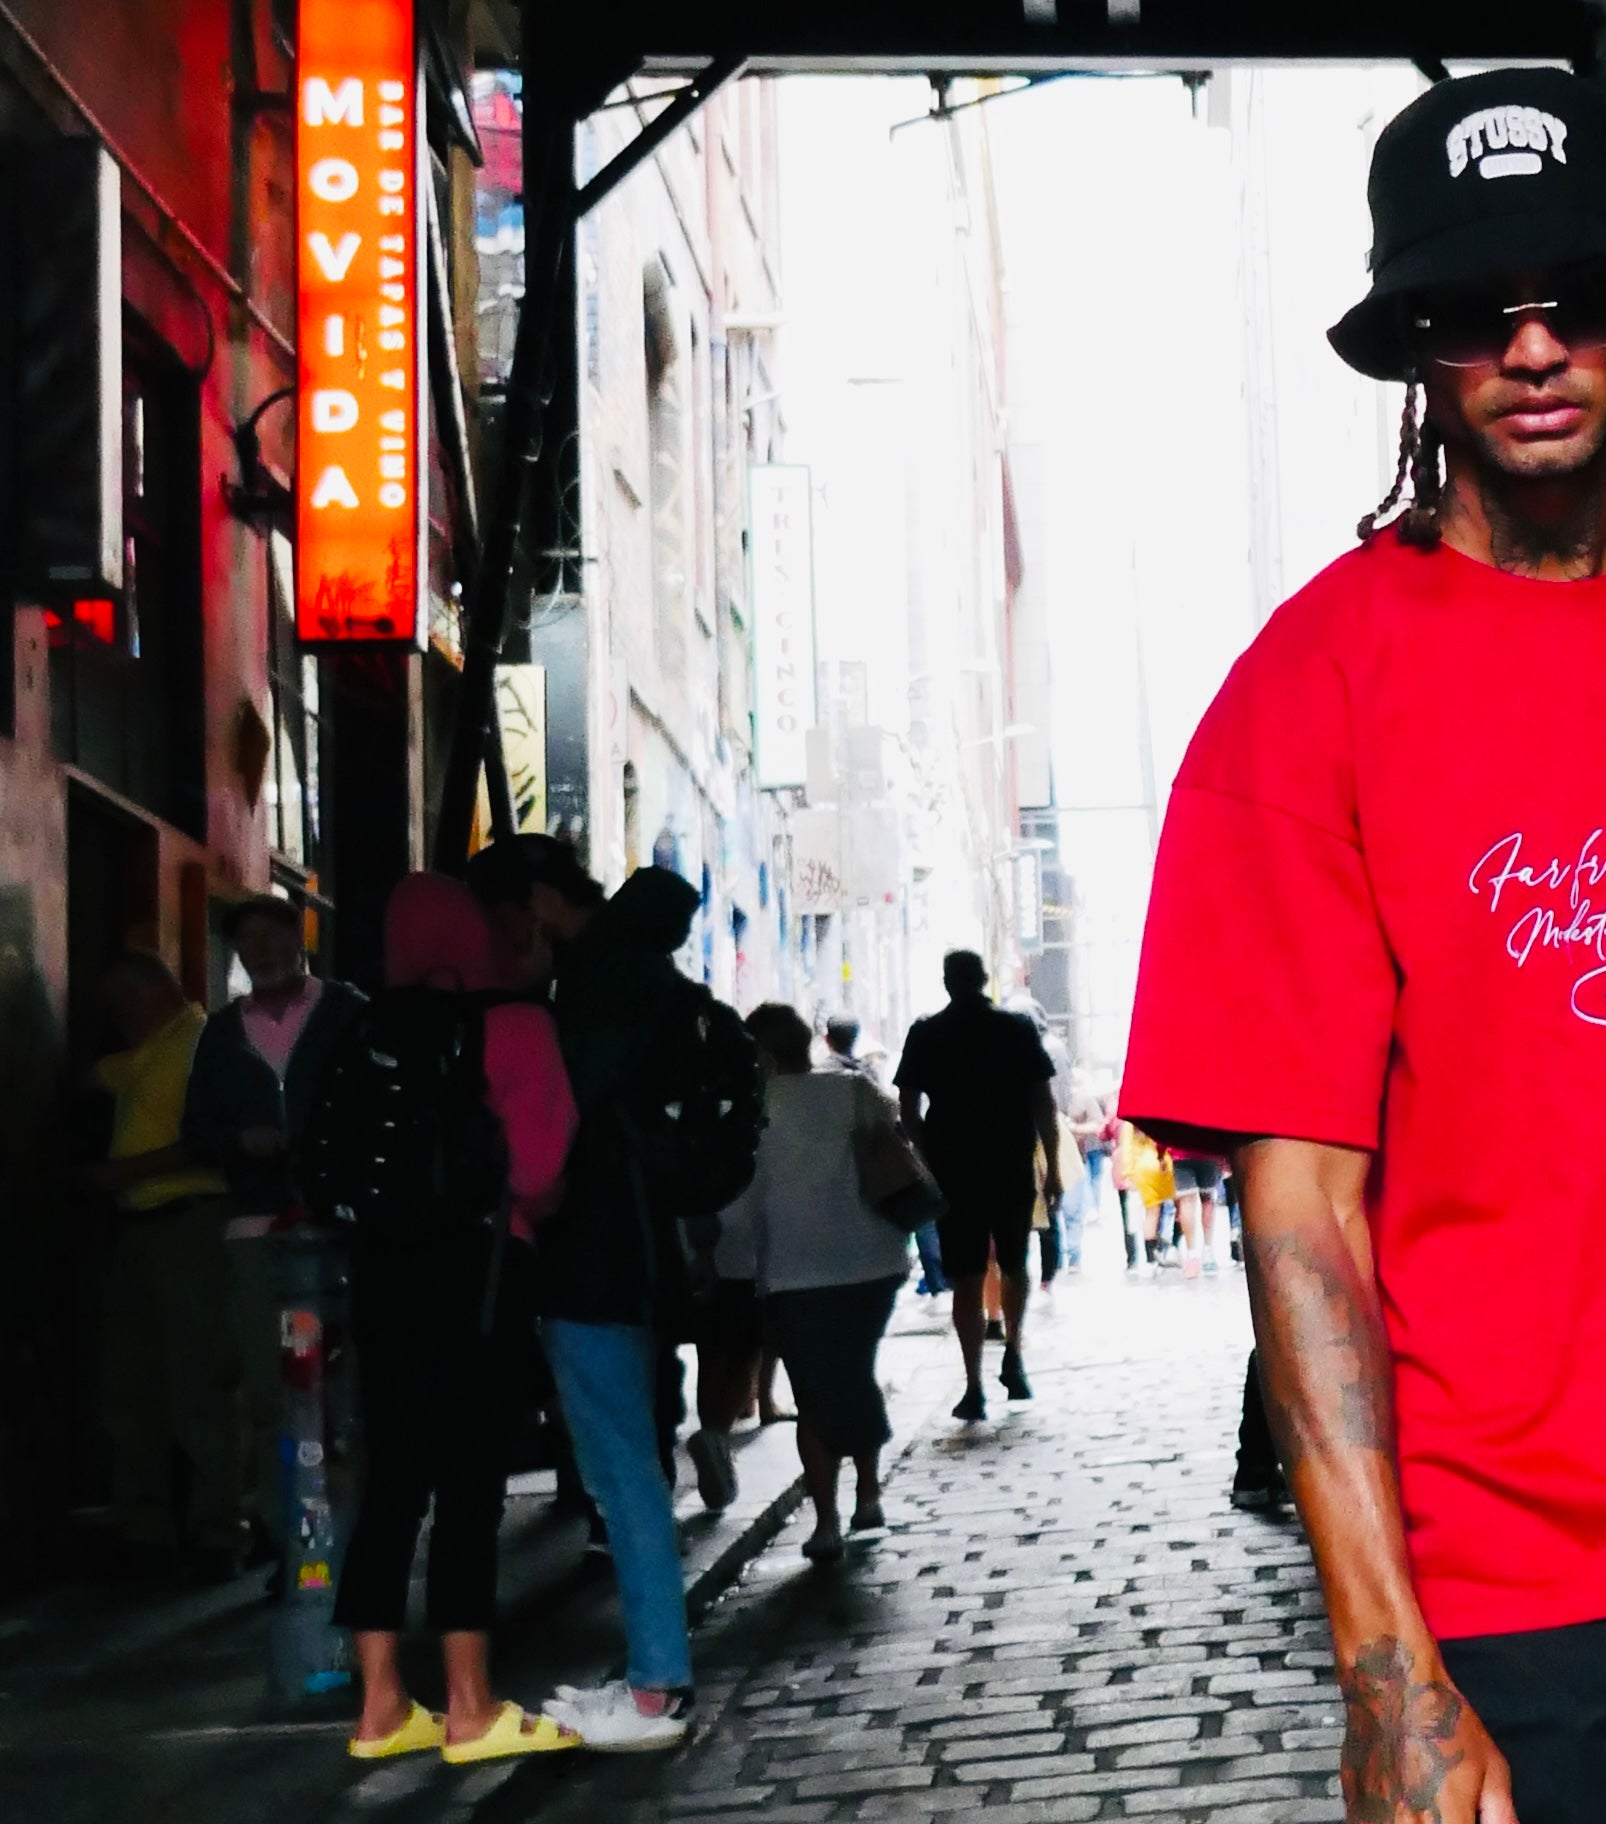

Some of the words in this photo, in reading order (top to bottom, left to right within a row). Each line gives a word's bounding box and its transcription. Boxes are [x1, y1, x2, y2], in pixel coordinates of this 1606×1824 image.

[379, 80, 405, 150] BAR
[379, 169, 405, 217] DE
[303, 76, 364, 509] MOVIDA
[379, 233, 405, 351] TAPAS
[379, 409, 406, 509] VINO
[775, 610, 797, 734] CINCO
